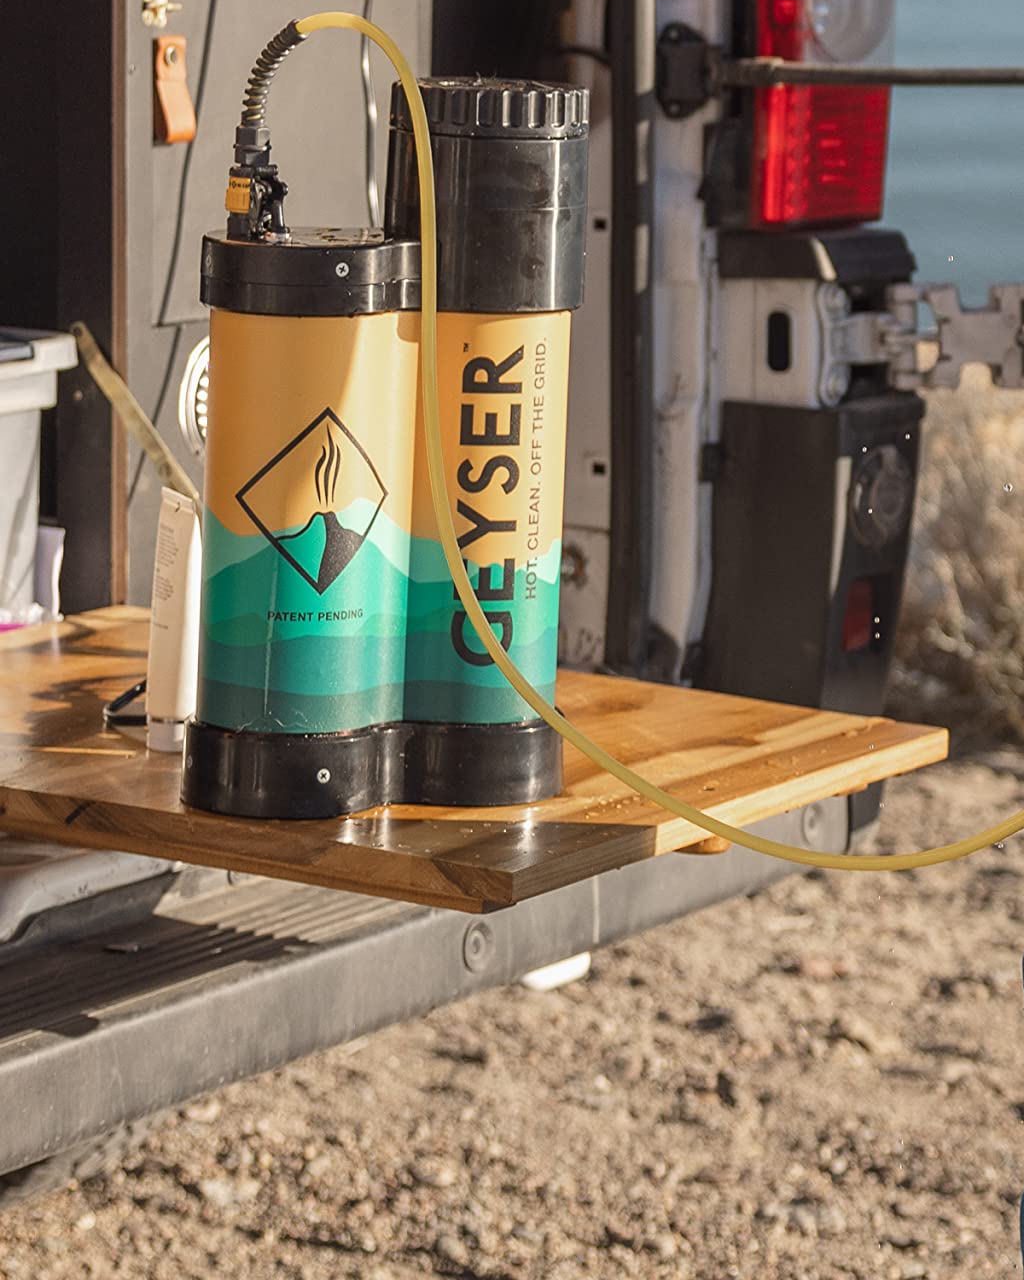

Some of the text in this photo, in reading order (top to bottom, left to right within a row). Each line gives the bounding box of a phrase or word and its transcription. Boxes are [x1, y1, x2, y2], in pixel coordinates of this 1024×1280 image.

[451, 345, 524, 667] GEYSER
[525, 337, 547, 600] HOT. CLEAN. OFF THE GRID.
[267, 608, 364, 622] PATENT PENDING
